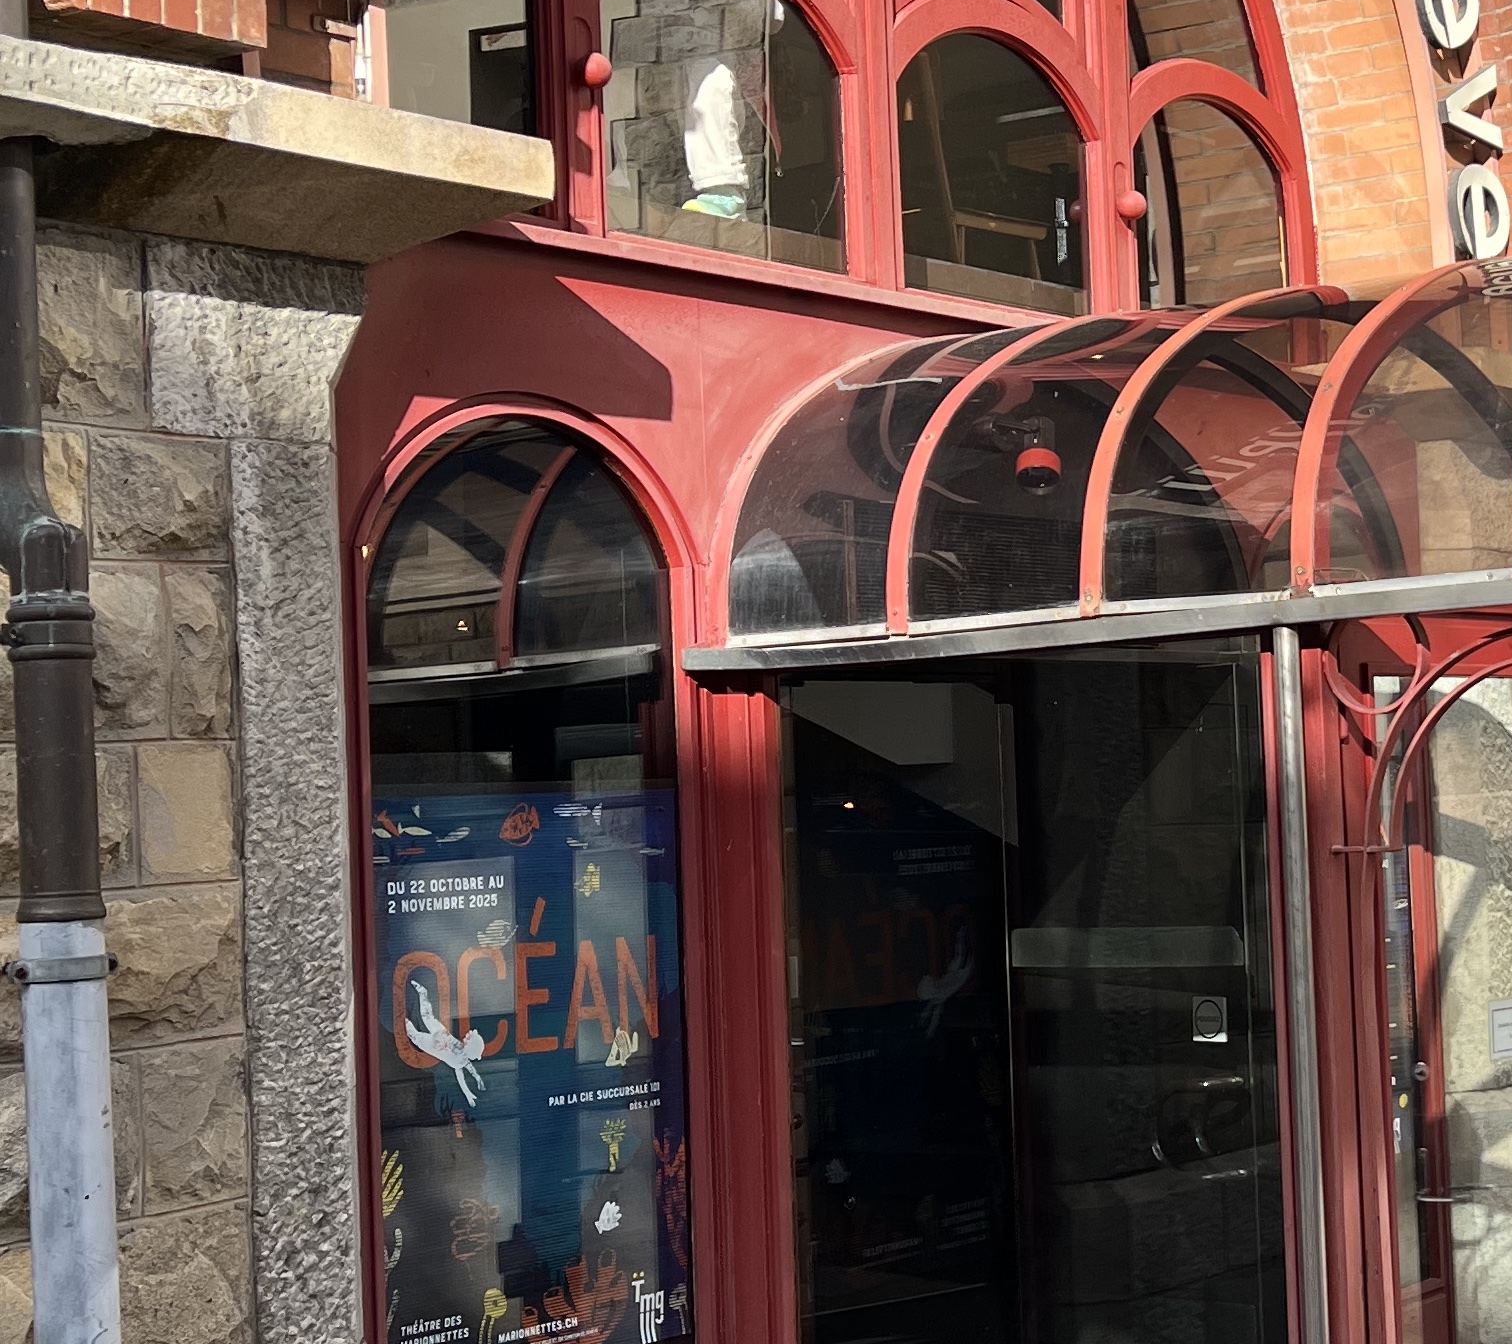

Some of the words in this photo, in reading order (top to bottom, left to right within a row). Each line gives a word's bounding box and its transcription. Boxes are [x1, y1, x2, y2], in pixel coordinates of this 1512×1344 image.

[387, 882, 405, 895] DU
[410, 880, 425, 894] 22
[430, 876, 484, 893] OCTOBRE
[488, 875, 504, 889] AU
[388, 901, 396, 914] 2
[401, 896, 465, 913] NOVEMBRE
[469, 894, 498, 908] 2025
[392, 897, 660, 1070] OCÉAN
[548, 1096, 565, 1107] PAR
[567, 1093, 578, 1104] LA
[580, 1091, 594, 1102] CIE
[597, 1083, 648, 1100] SUCCURSALE
[401, 1318, 442, 1337] THÉÂTRE
[444, 1315, 462, 1328] DES
[498, 1316, 578, 1344] MARIONNETTES.CH
